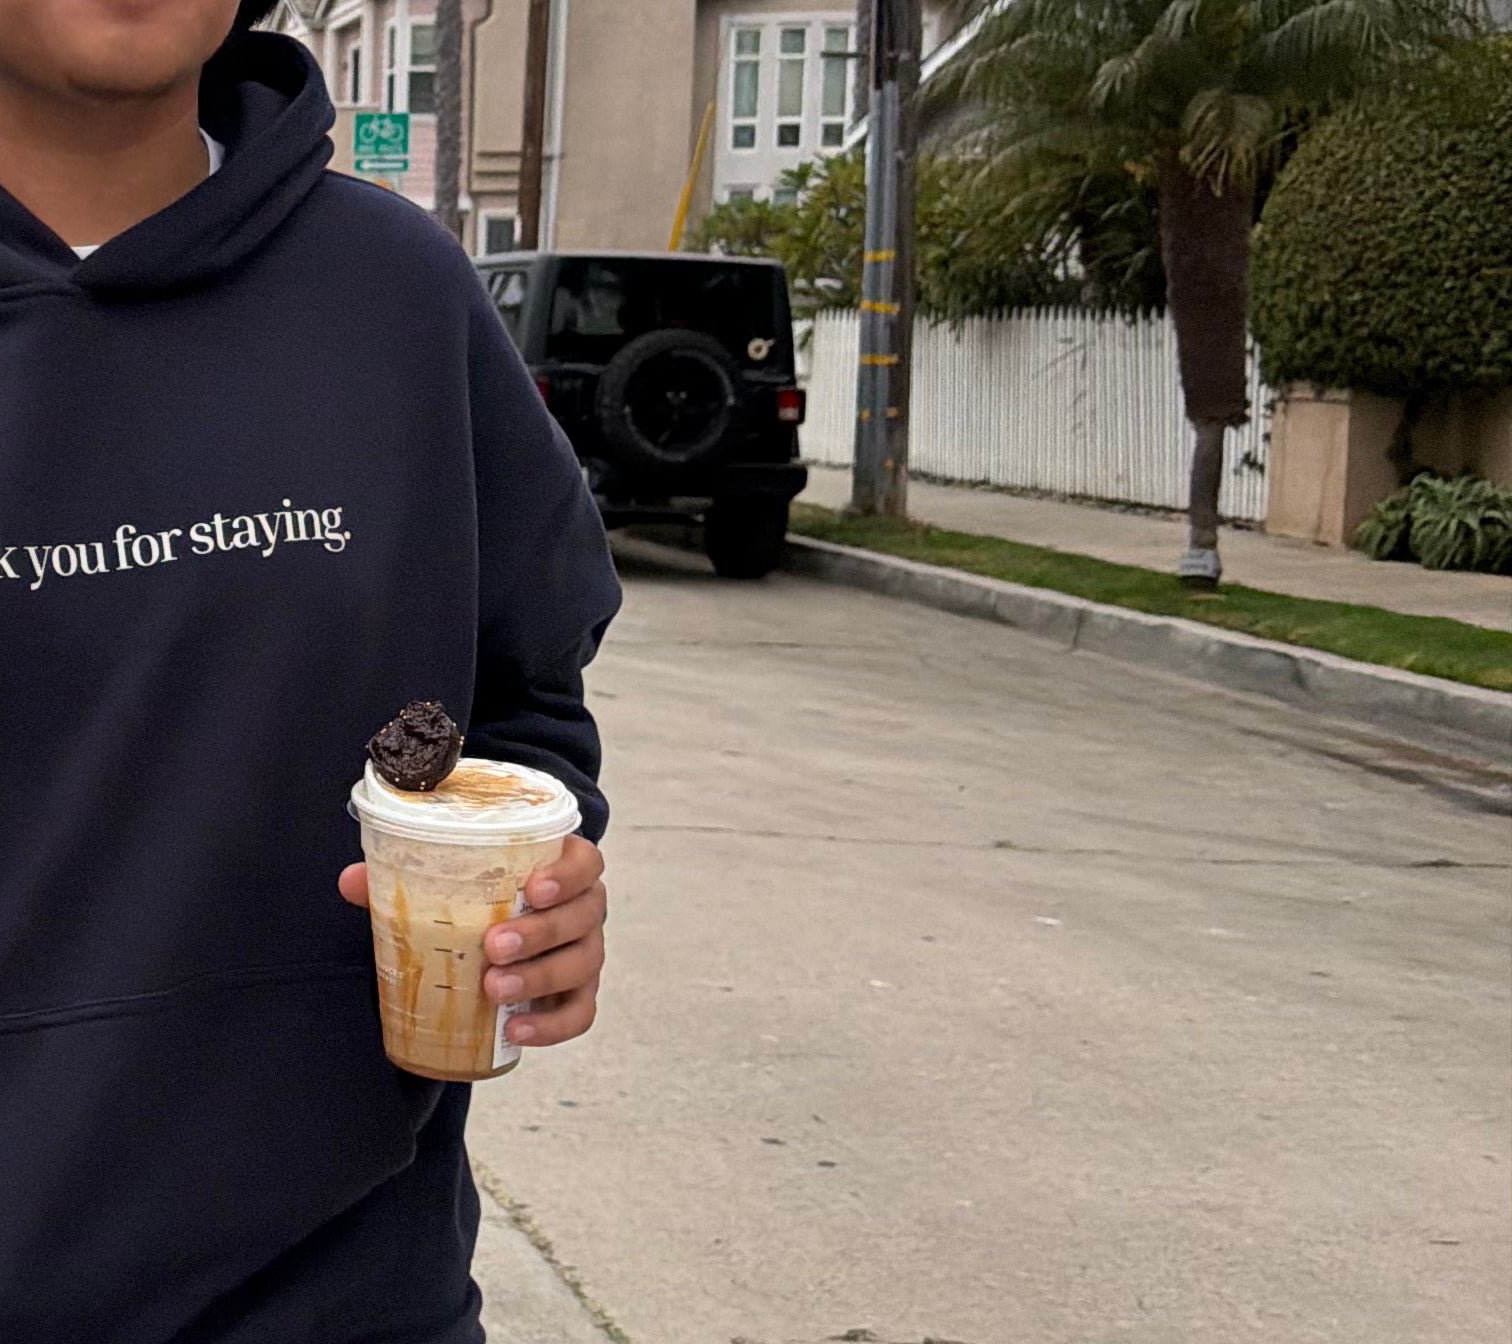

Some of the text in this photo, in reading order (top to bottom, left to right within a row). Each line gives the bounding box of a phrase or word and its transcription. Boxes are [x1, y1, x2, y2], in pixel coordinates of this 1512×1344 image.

[23, 541, 110, 591] you
[112, 524, 183, 571] for
[188, 498, 352, 558] staying.
